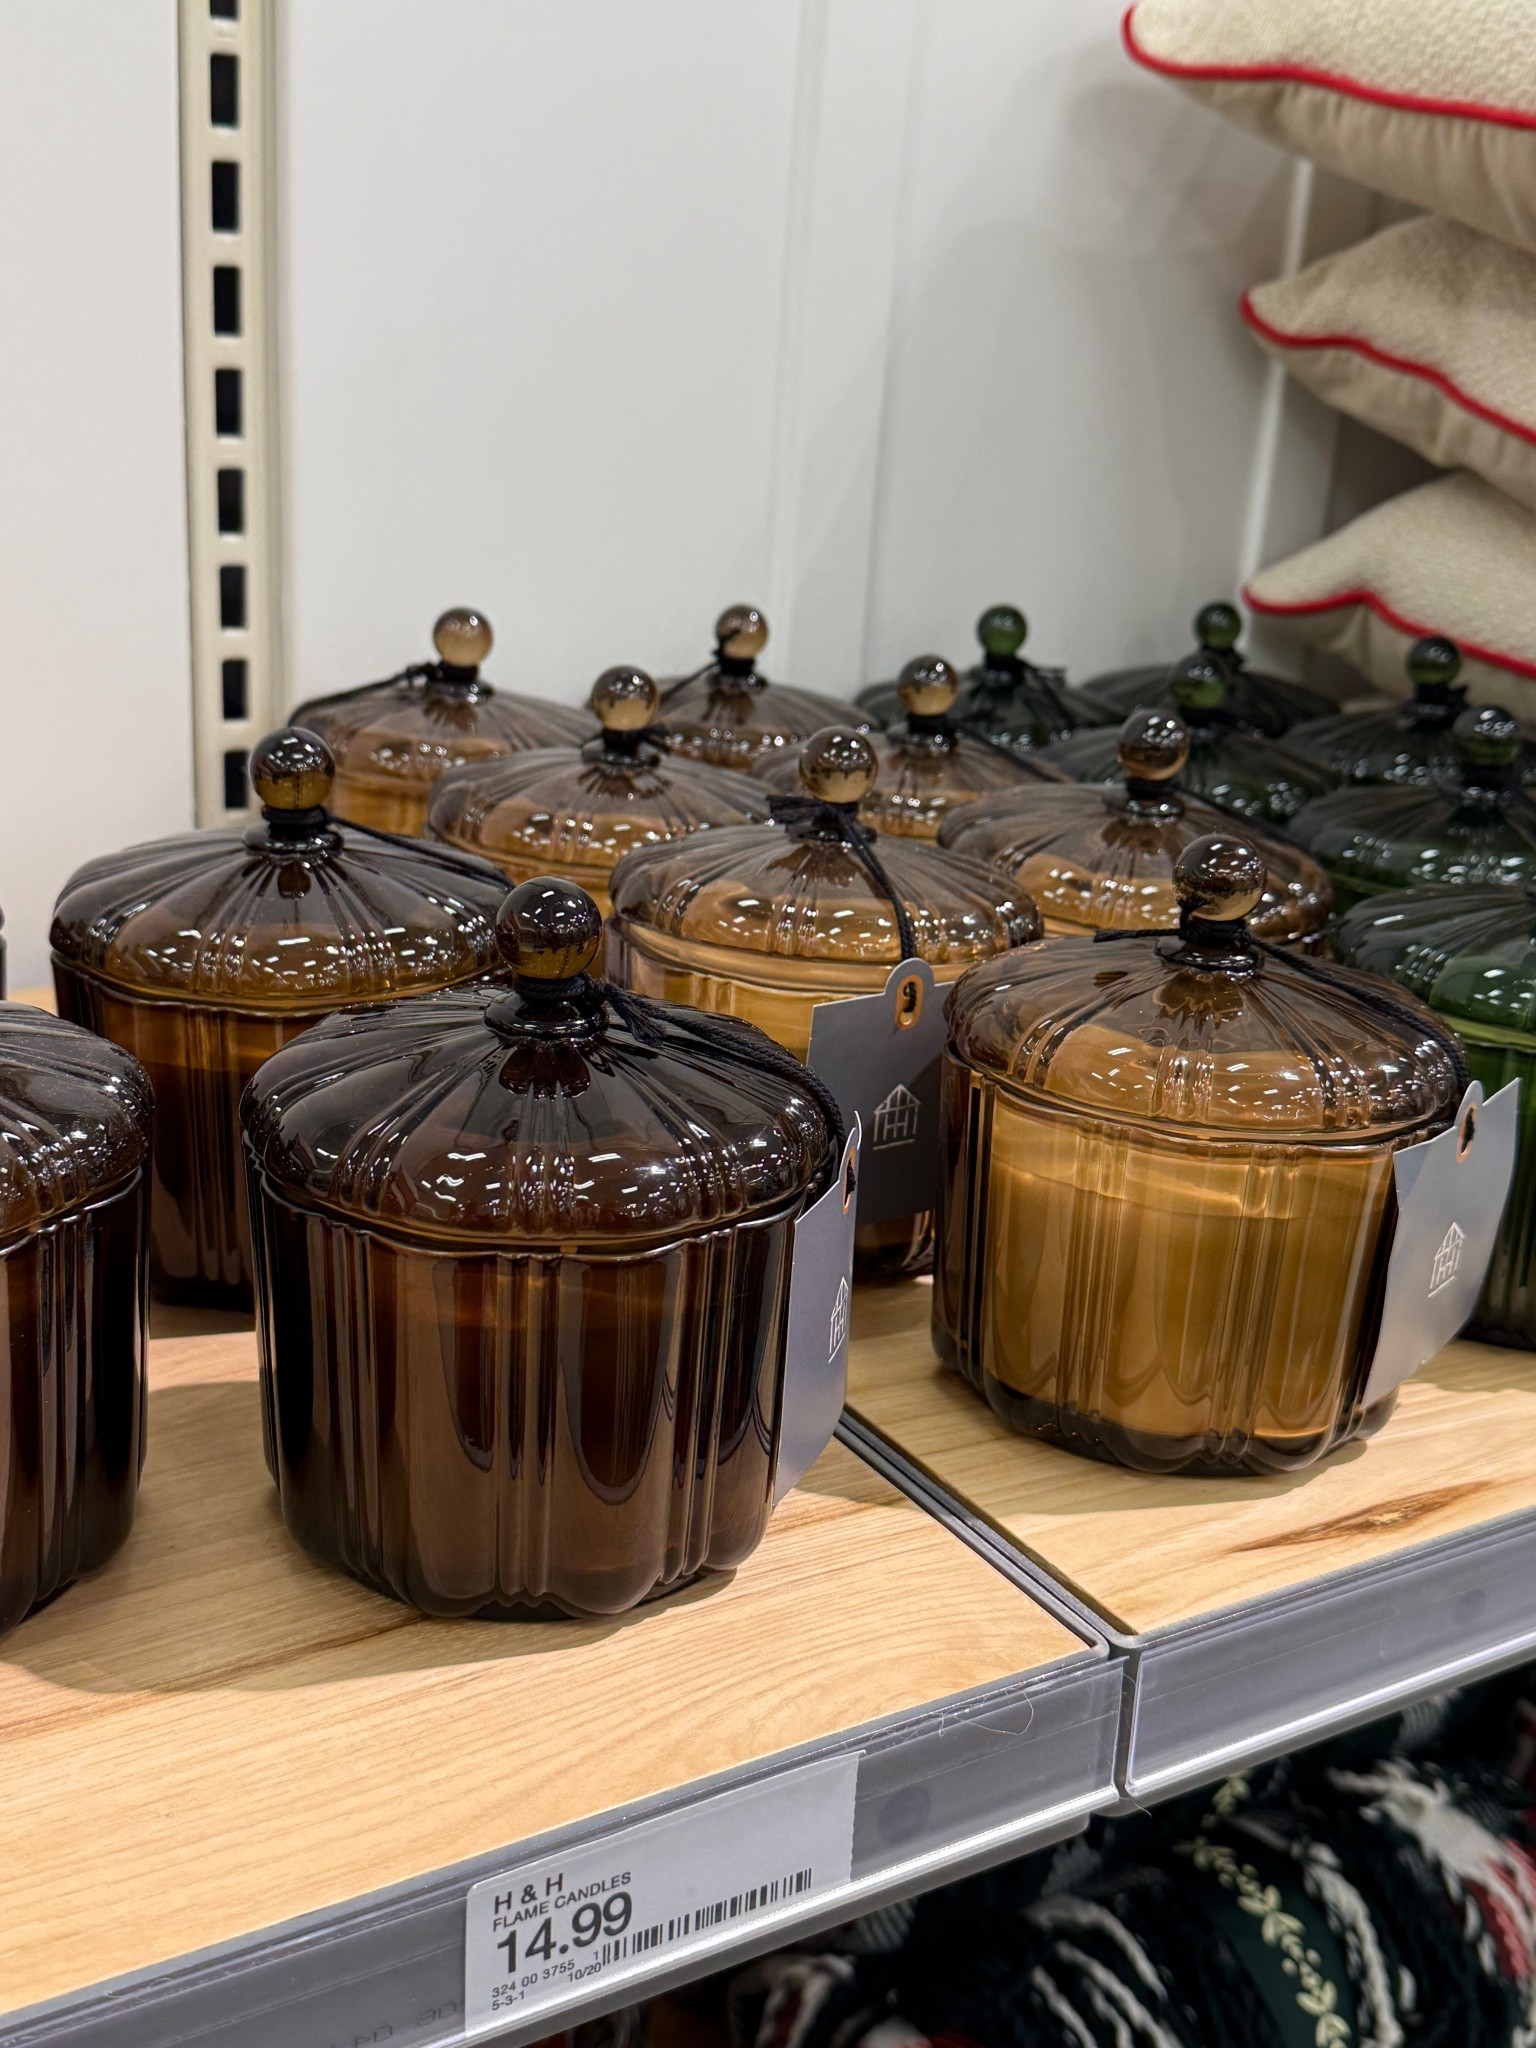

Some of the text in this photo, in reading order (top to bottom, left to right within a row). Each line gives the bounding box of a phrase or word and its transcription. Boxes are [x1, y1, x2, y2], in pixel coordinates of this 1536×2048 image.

[493, 1872, 631, 1932] FLAME CANDLES
[494, 1872, 563, 1915] H & H
[497, 1891, 633, 1974] 14.99
[492, 1981, 516, 1998] 324
[522, 1973, 538, 1987] 00
[542, 1959, 575, 1980] 3755
[492, 1962, 602, 2011] 5-3-1 10/20
